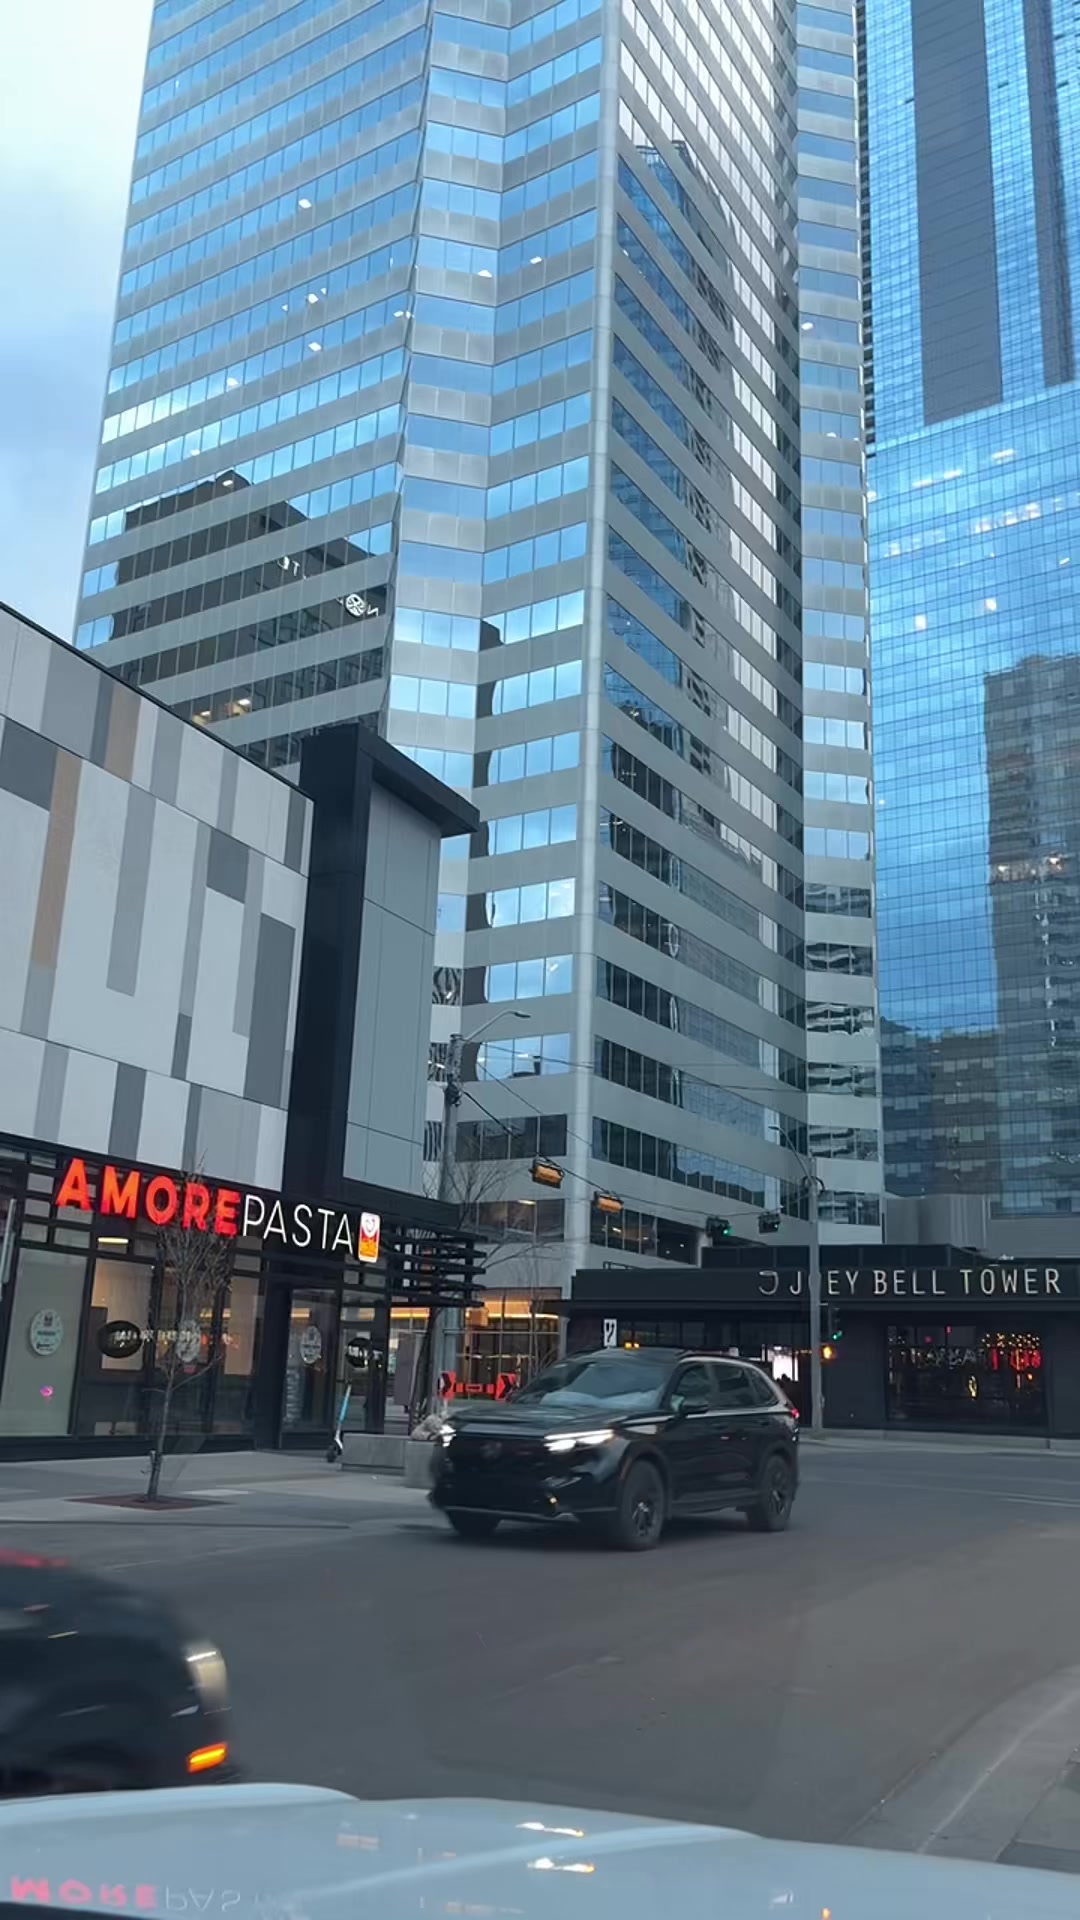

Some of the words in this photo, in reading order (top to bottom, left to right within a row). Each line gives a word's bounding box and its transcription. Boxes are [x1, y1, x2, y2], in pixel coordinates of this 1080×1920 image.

[55, 1157, 240, 1238] AMORE
[241, 1194, 353, 1255] PASTA
[789, 1270, 859, 1295] JEY
[873, 1269, 946, 1295] BELL
[960, 1268, 1062, 1295] TOWER
